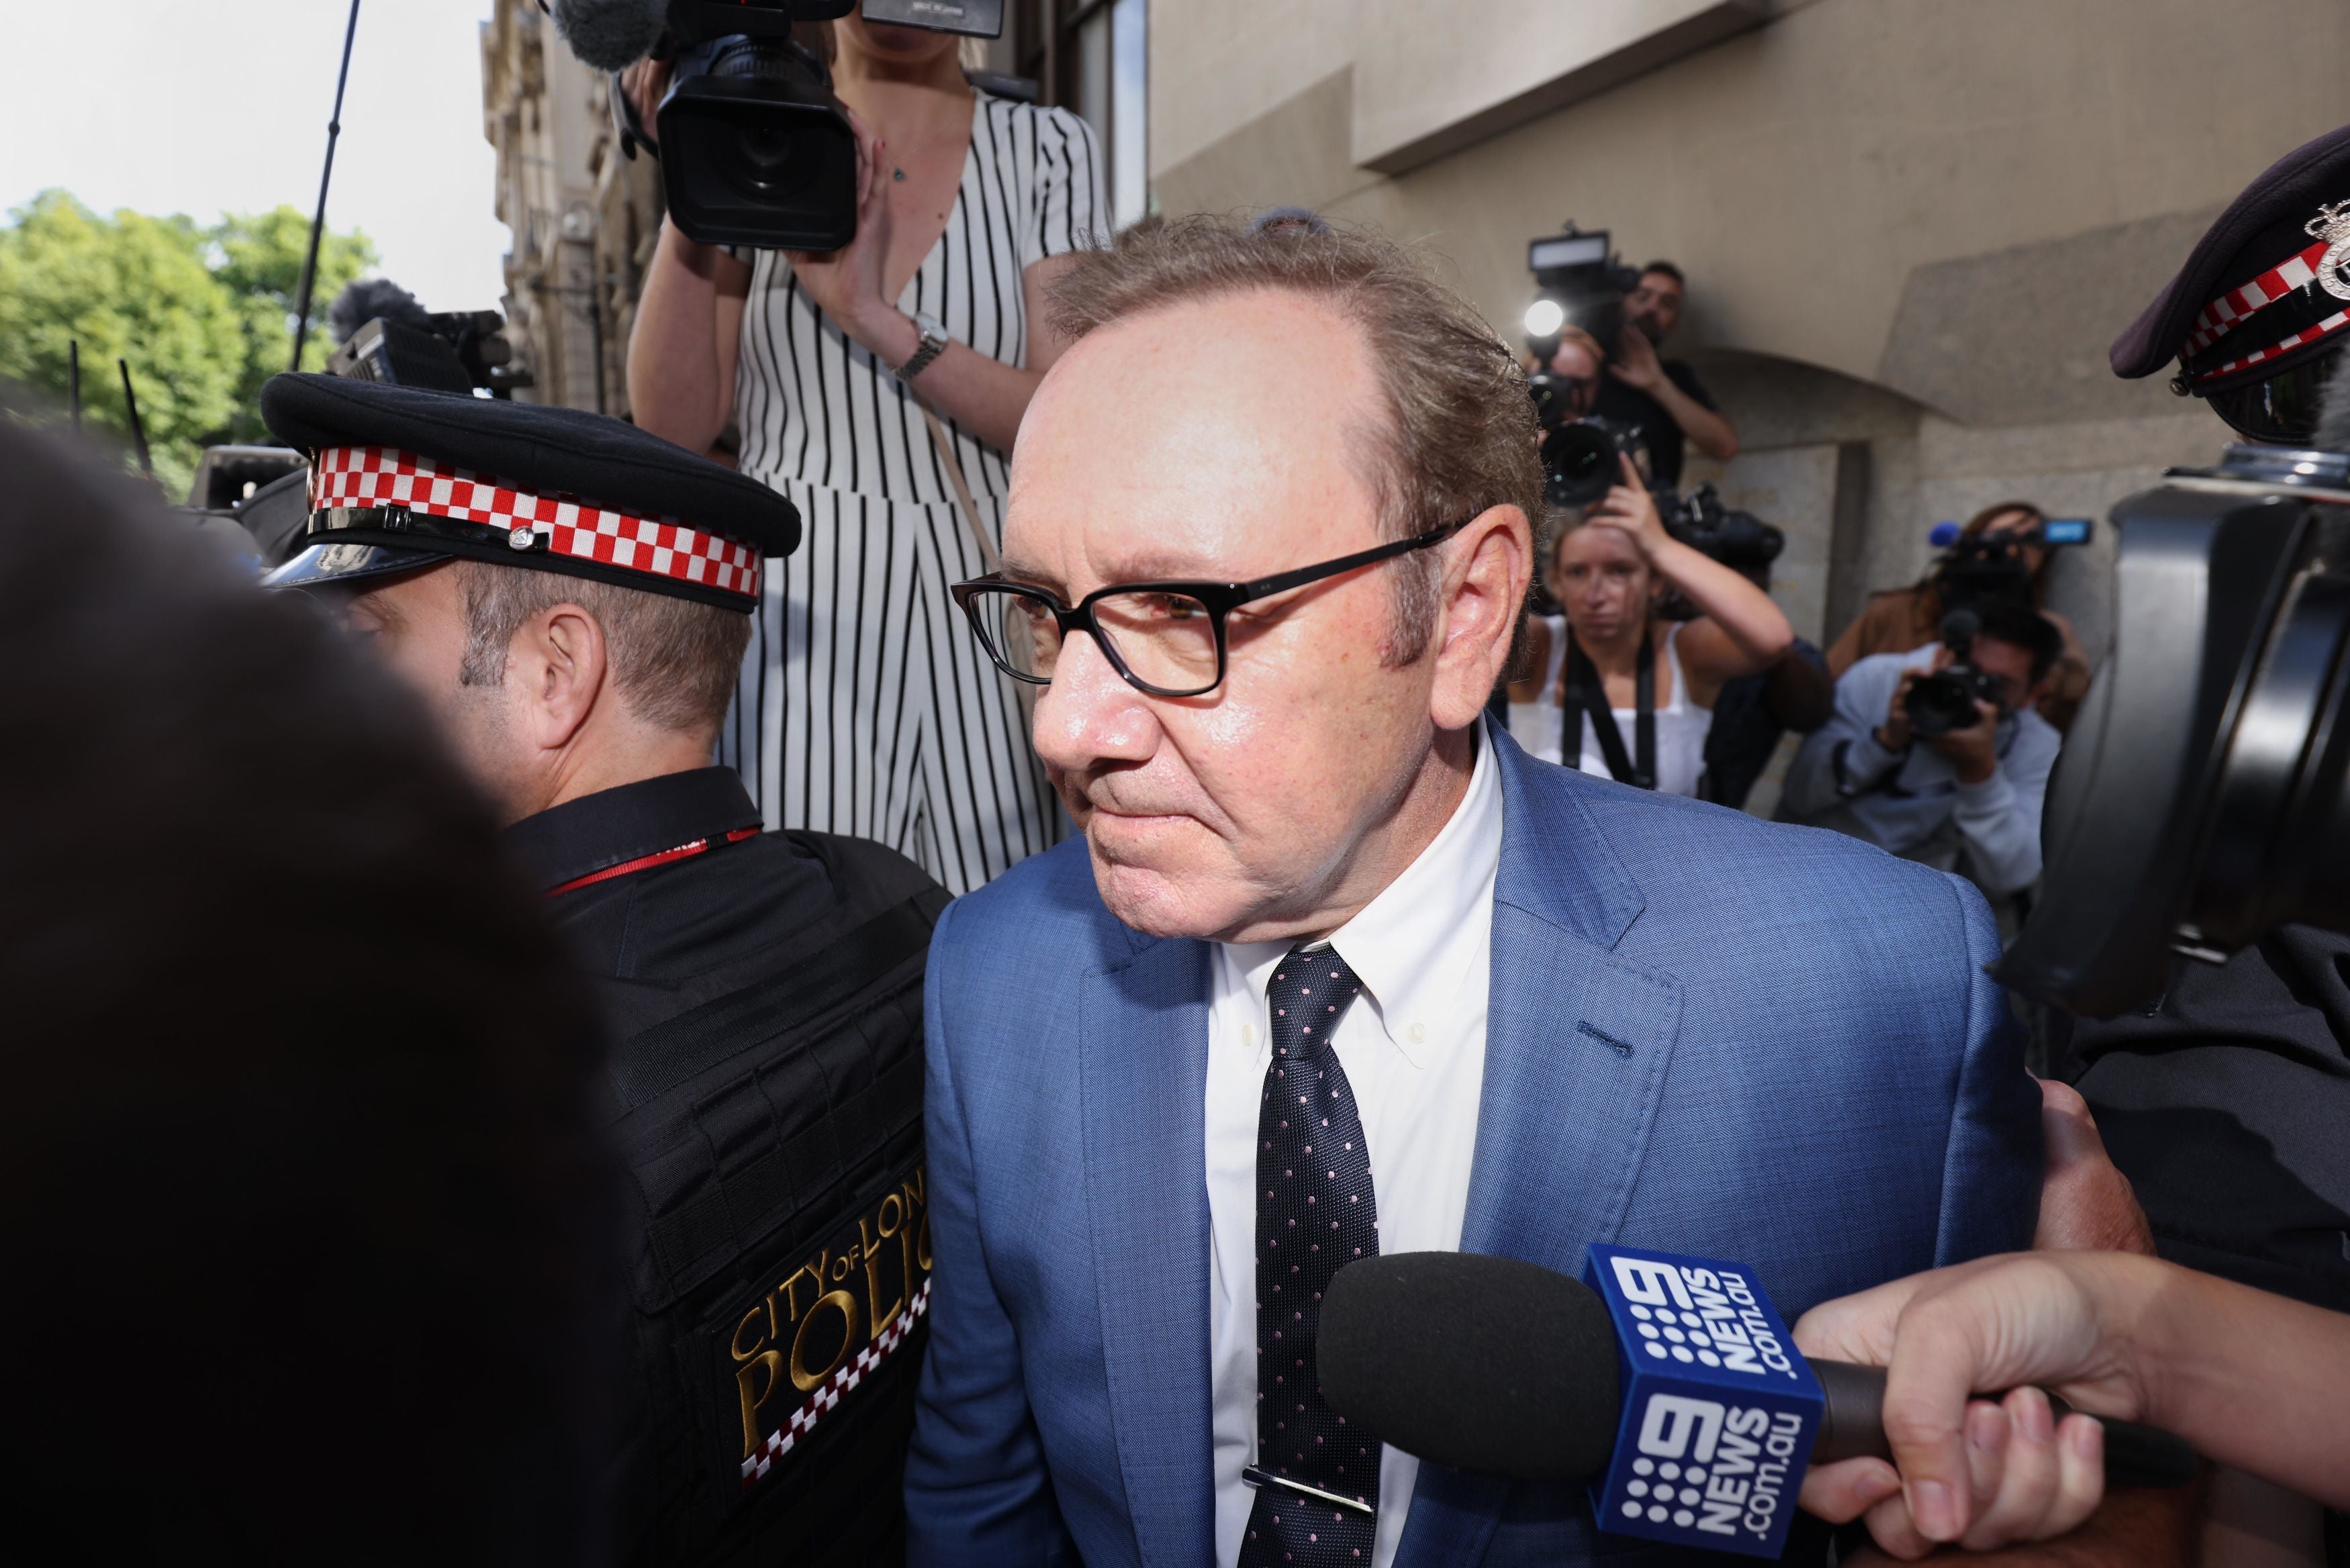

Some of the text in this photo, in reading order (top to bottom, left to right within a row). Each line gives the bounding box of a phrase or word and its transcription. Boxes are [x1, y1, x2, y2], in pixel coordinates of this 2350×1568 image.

[913, 2, 931, 10] MADE
[943, 6, 963, 15] JAPAN
[732, 1247, 830, 1361] CITY
[832, 1244, 860, 1281] OF
[1610, 1256, 1694, 1311] 9
[1680, 1266, 1767, 1375] NEWS
[1718, 1271, 1799, 1380] .com.au
[1637, 1393, 1726, 1464] 9
[1696, 1406, 1770, 1536] NEWS
[1743, 1411, 1803, 1541] .com.au
